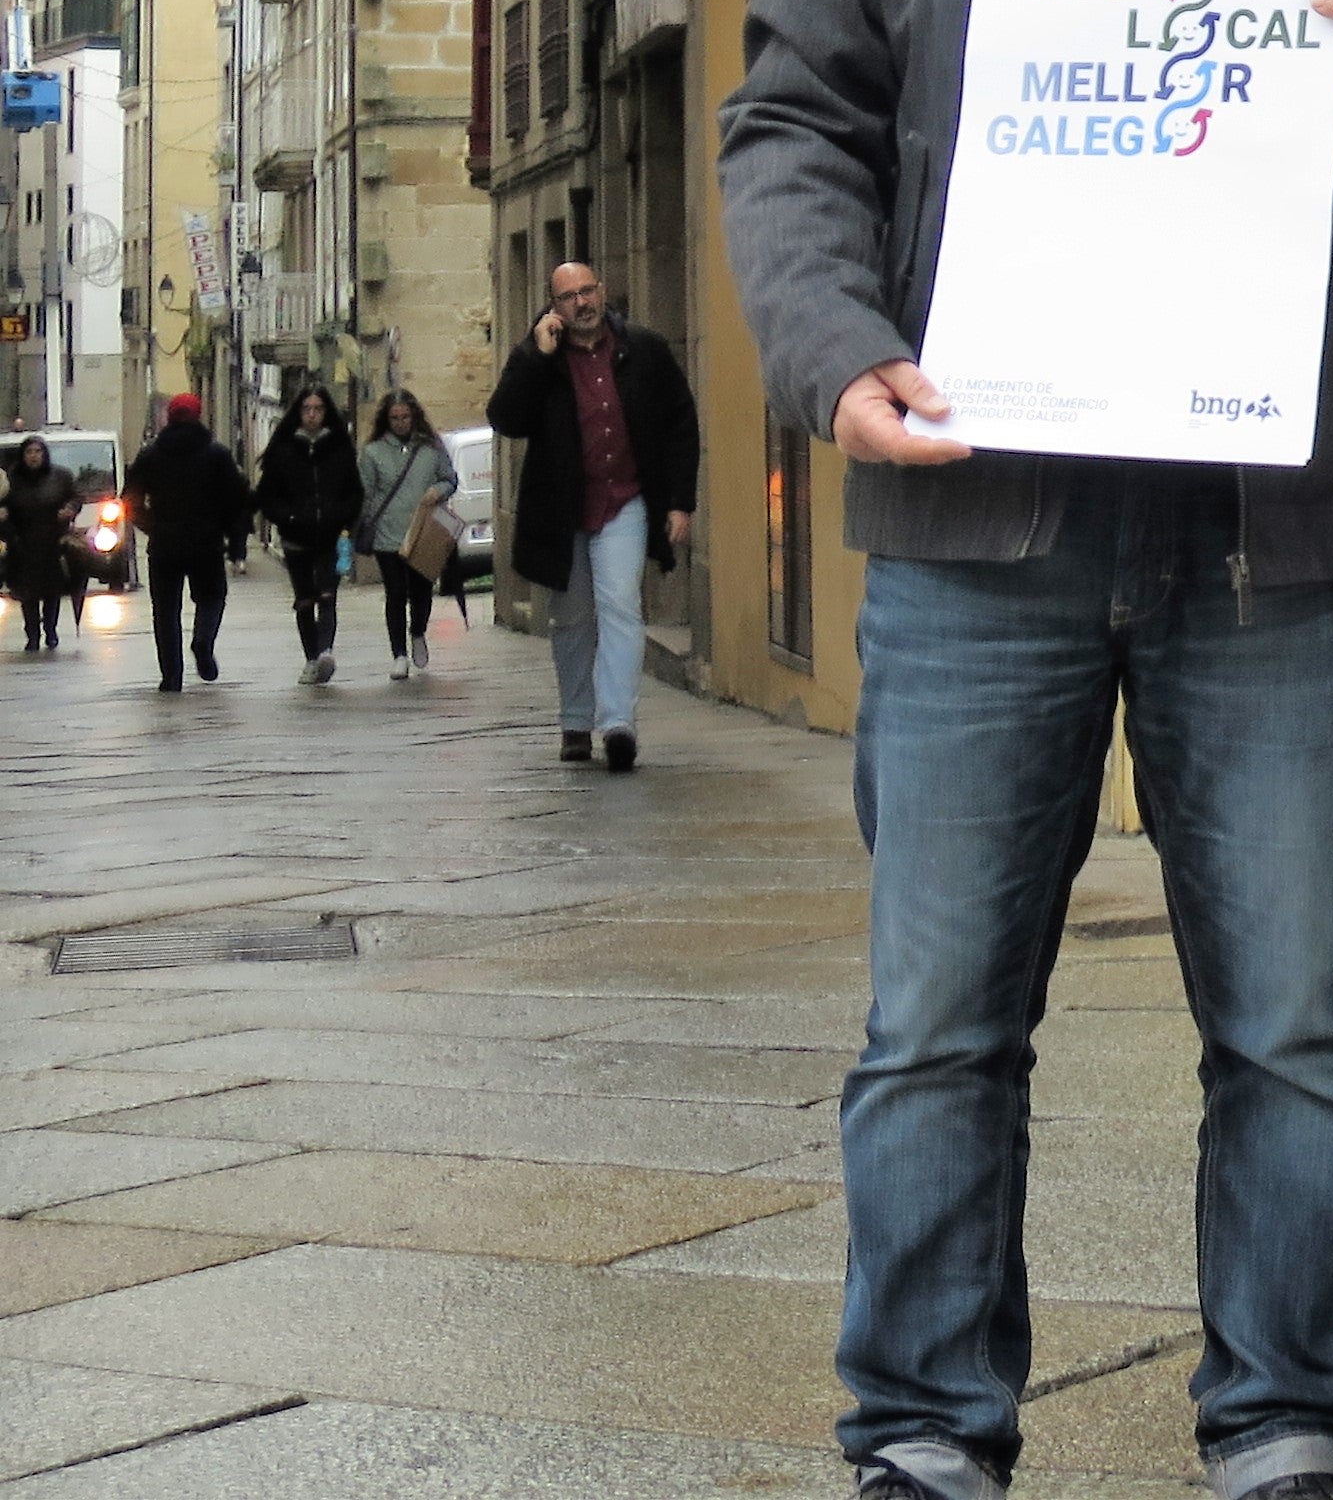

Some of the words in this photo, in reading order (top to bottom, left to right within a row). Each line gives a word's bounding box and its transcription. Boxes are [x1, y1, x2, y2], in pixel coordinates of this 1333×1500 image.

[1126, 8, 1320, 51] LOCAL
[1021, 61, 1252, 102] MELLOR
[986, 109, 1213, 157] GALEGO
[953, 378, 963, 390] O
[966, 378, 1034, 394] MOMENTO
[1036, 382, 1053, 395] DE
[1003, 395, 1038, 408] POLO
[1040, 396, 1109, 411] COMERCIO
[960, 406, 1023, 420] PRODUTO
[1026, 410, 1079, 423] GALEGO
[1190, 389, 1242, 422] bng
